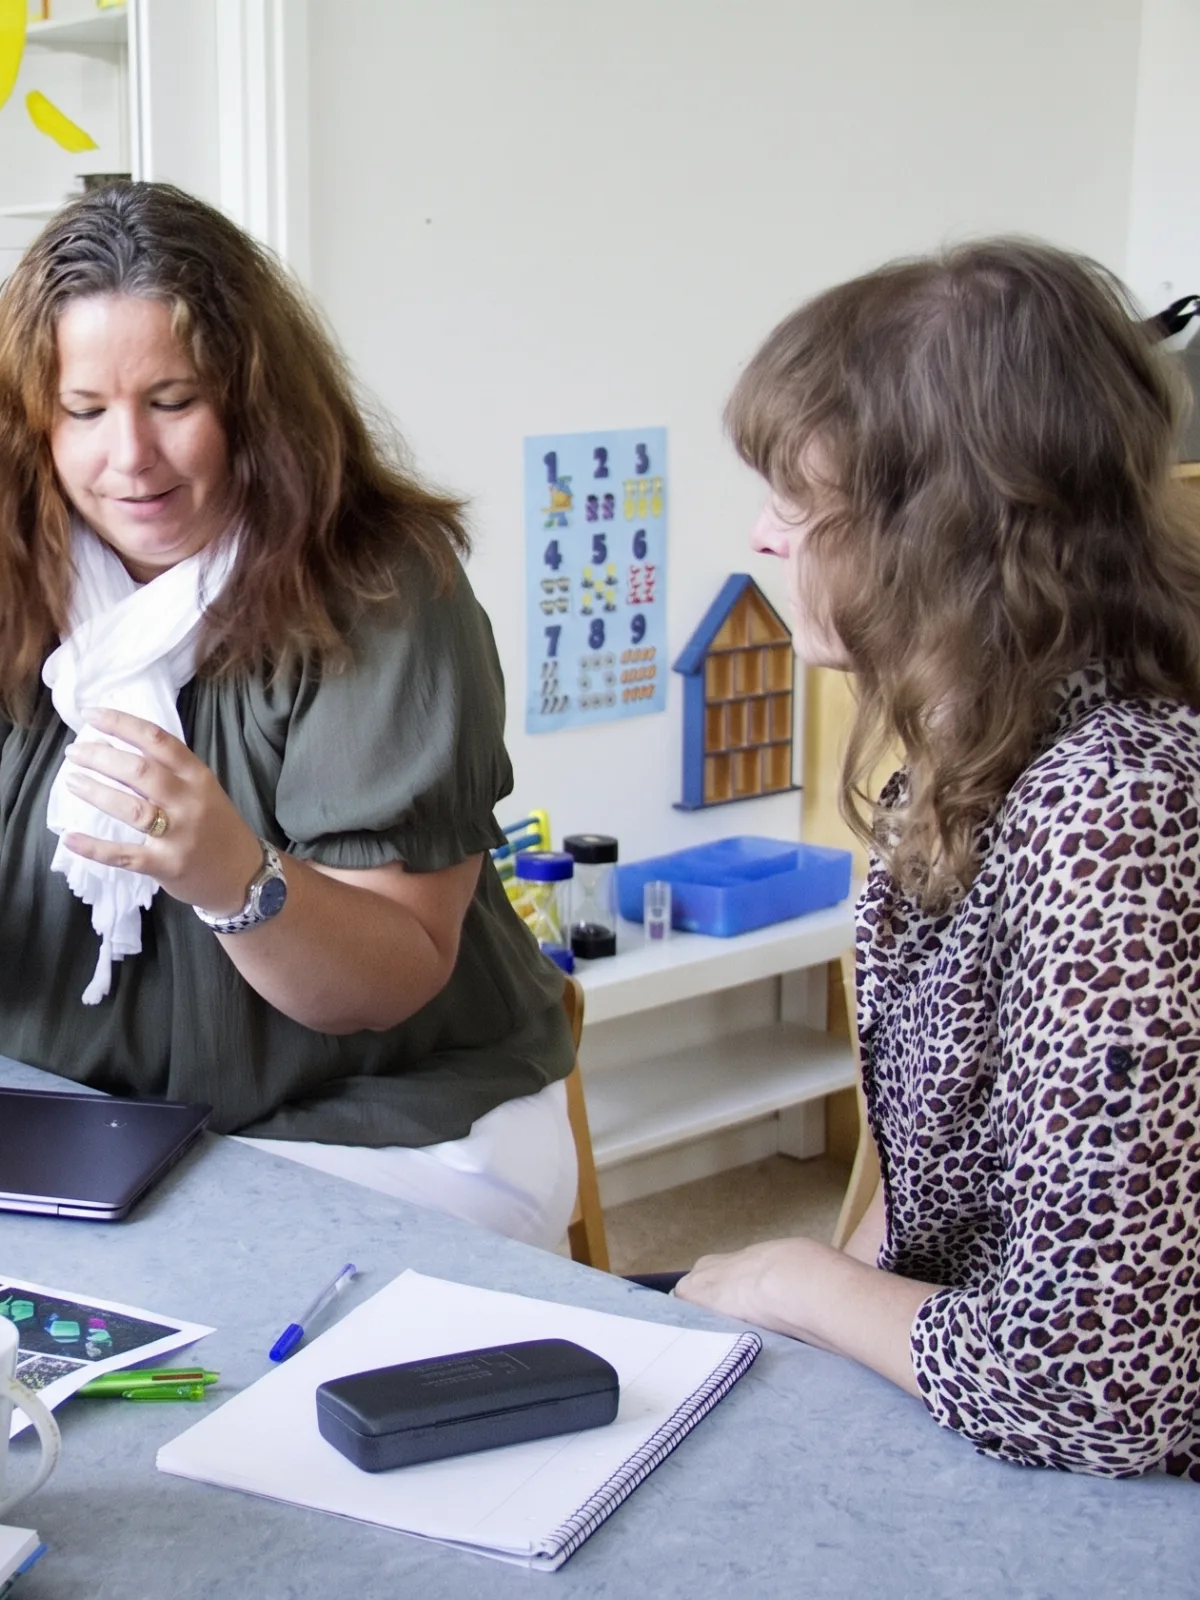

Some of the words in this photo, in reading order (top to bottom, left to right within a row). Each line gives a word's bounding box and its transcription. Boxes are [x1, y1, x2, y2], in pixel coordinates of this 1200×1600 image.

[543, 451, 558, 484] 1
[593, 446, 609, 479] 2
[635, 443, 650, 475] 3
[544, 540, 563, 571] 4
[592, 533, 608, 565] 5
[632, 529, 648, 560] 6
[545, 625, 562, 657] 7
[588, 618, 606, 650] 8
[630, 613, 647, 645] 9
